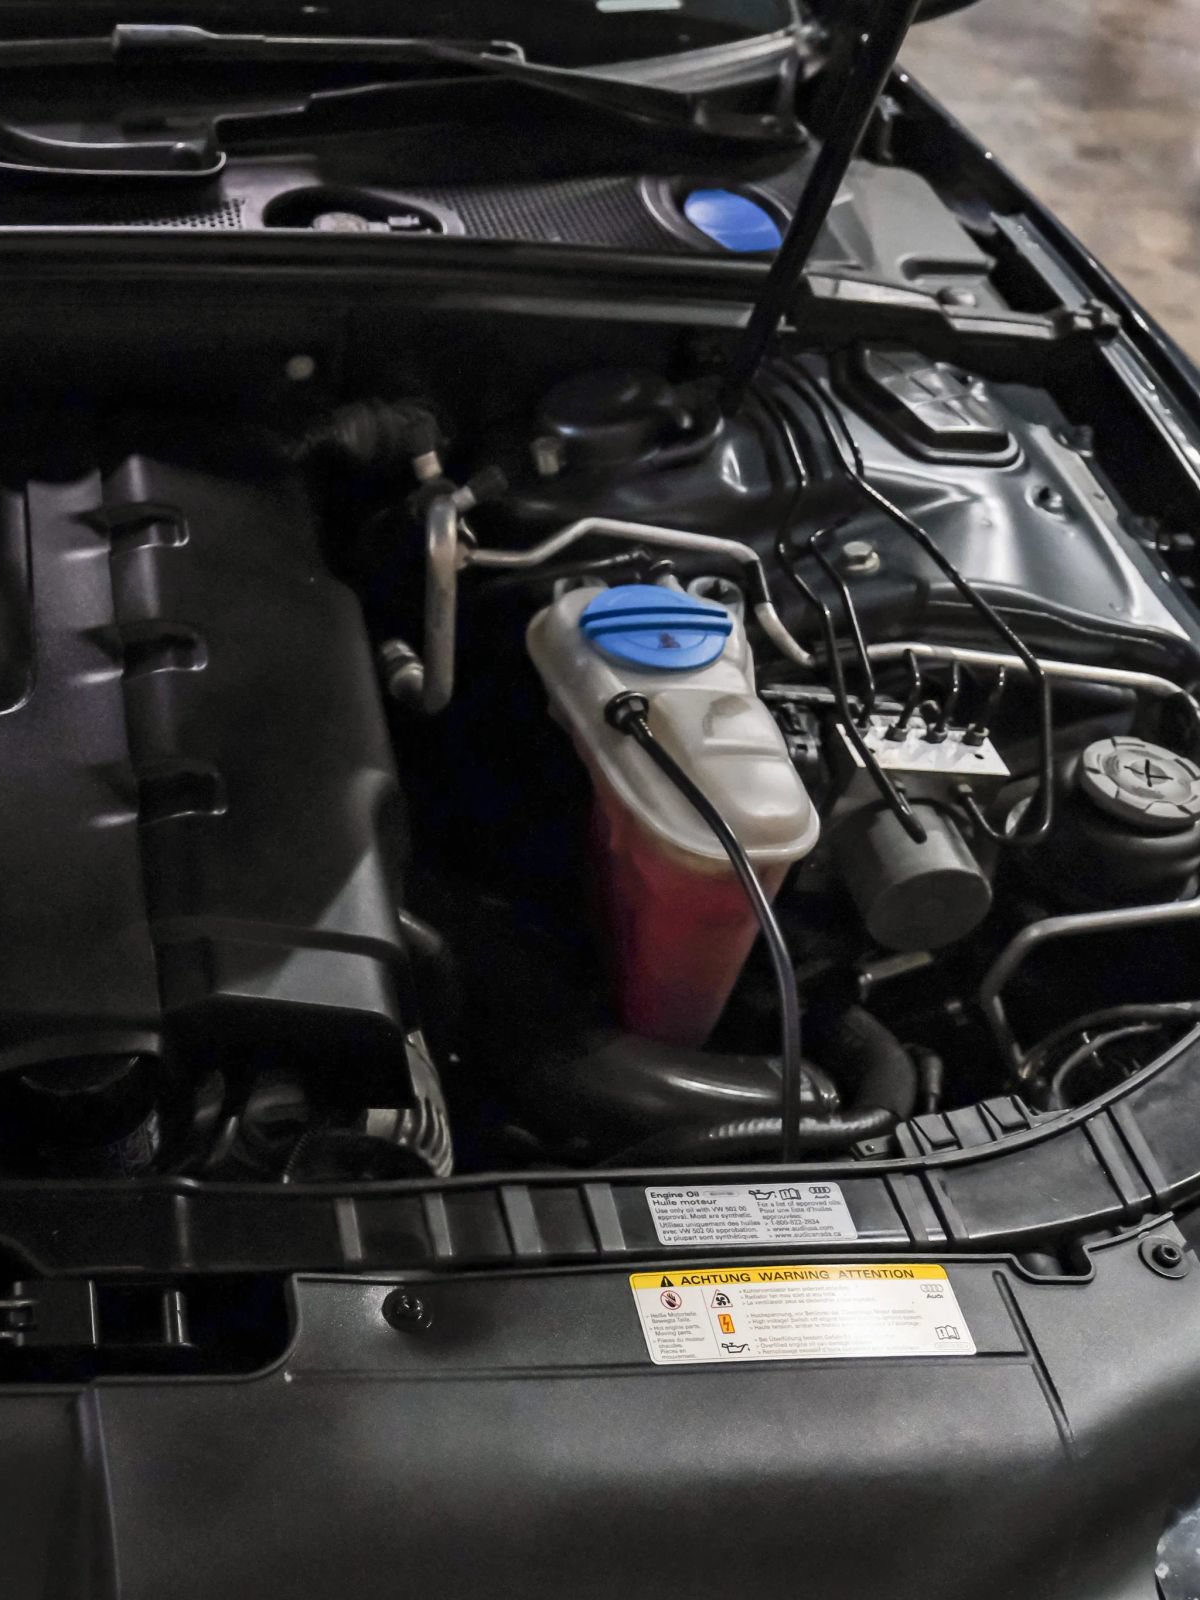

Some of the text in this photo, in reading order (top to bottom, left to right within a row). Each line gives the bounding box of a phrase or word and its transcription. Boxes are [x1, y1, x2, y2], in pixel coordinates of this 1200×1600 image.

[650, 1192, 684, 1200] Engine
[681, 1269, 915, 1285] ACHTUNG WARNING ATTENTION
